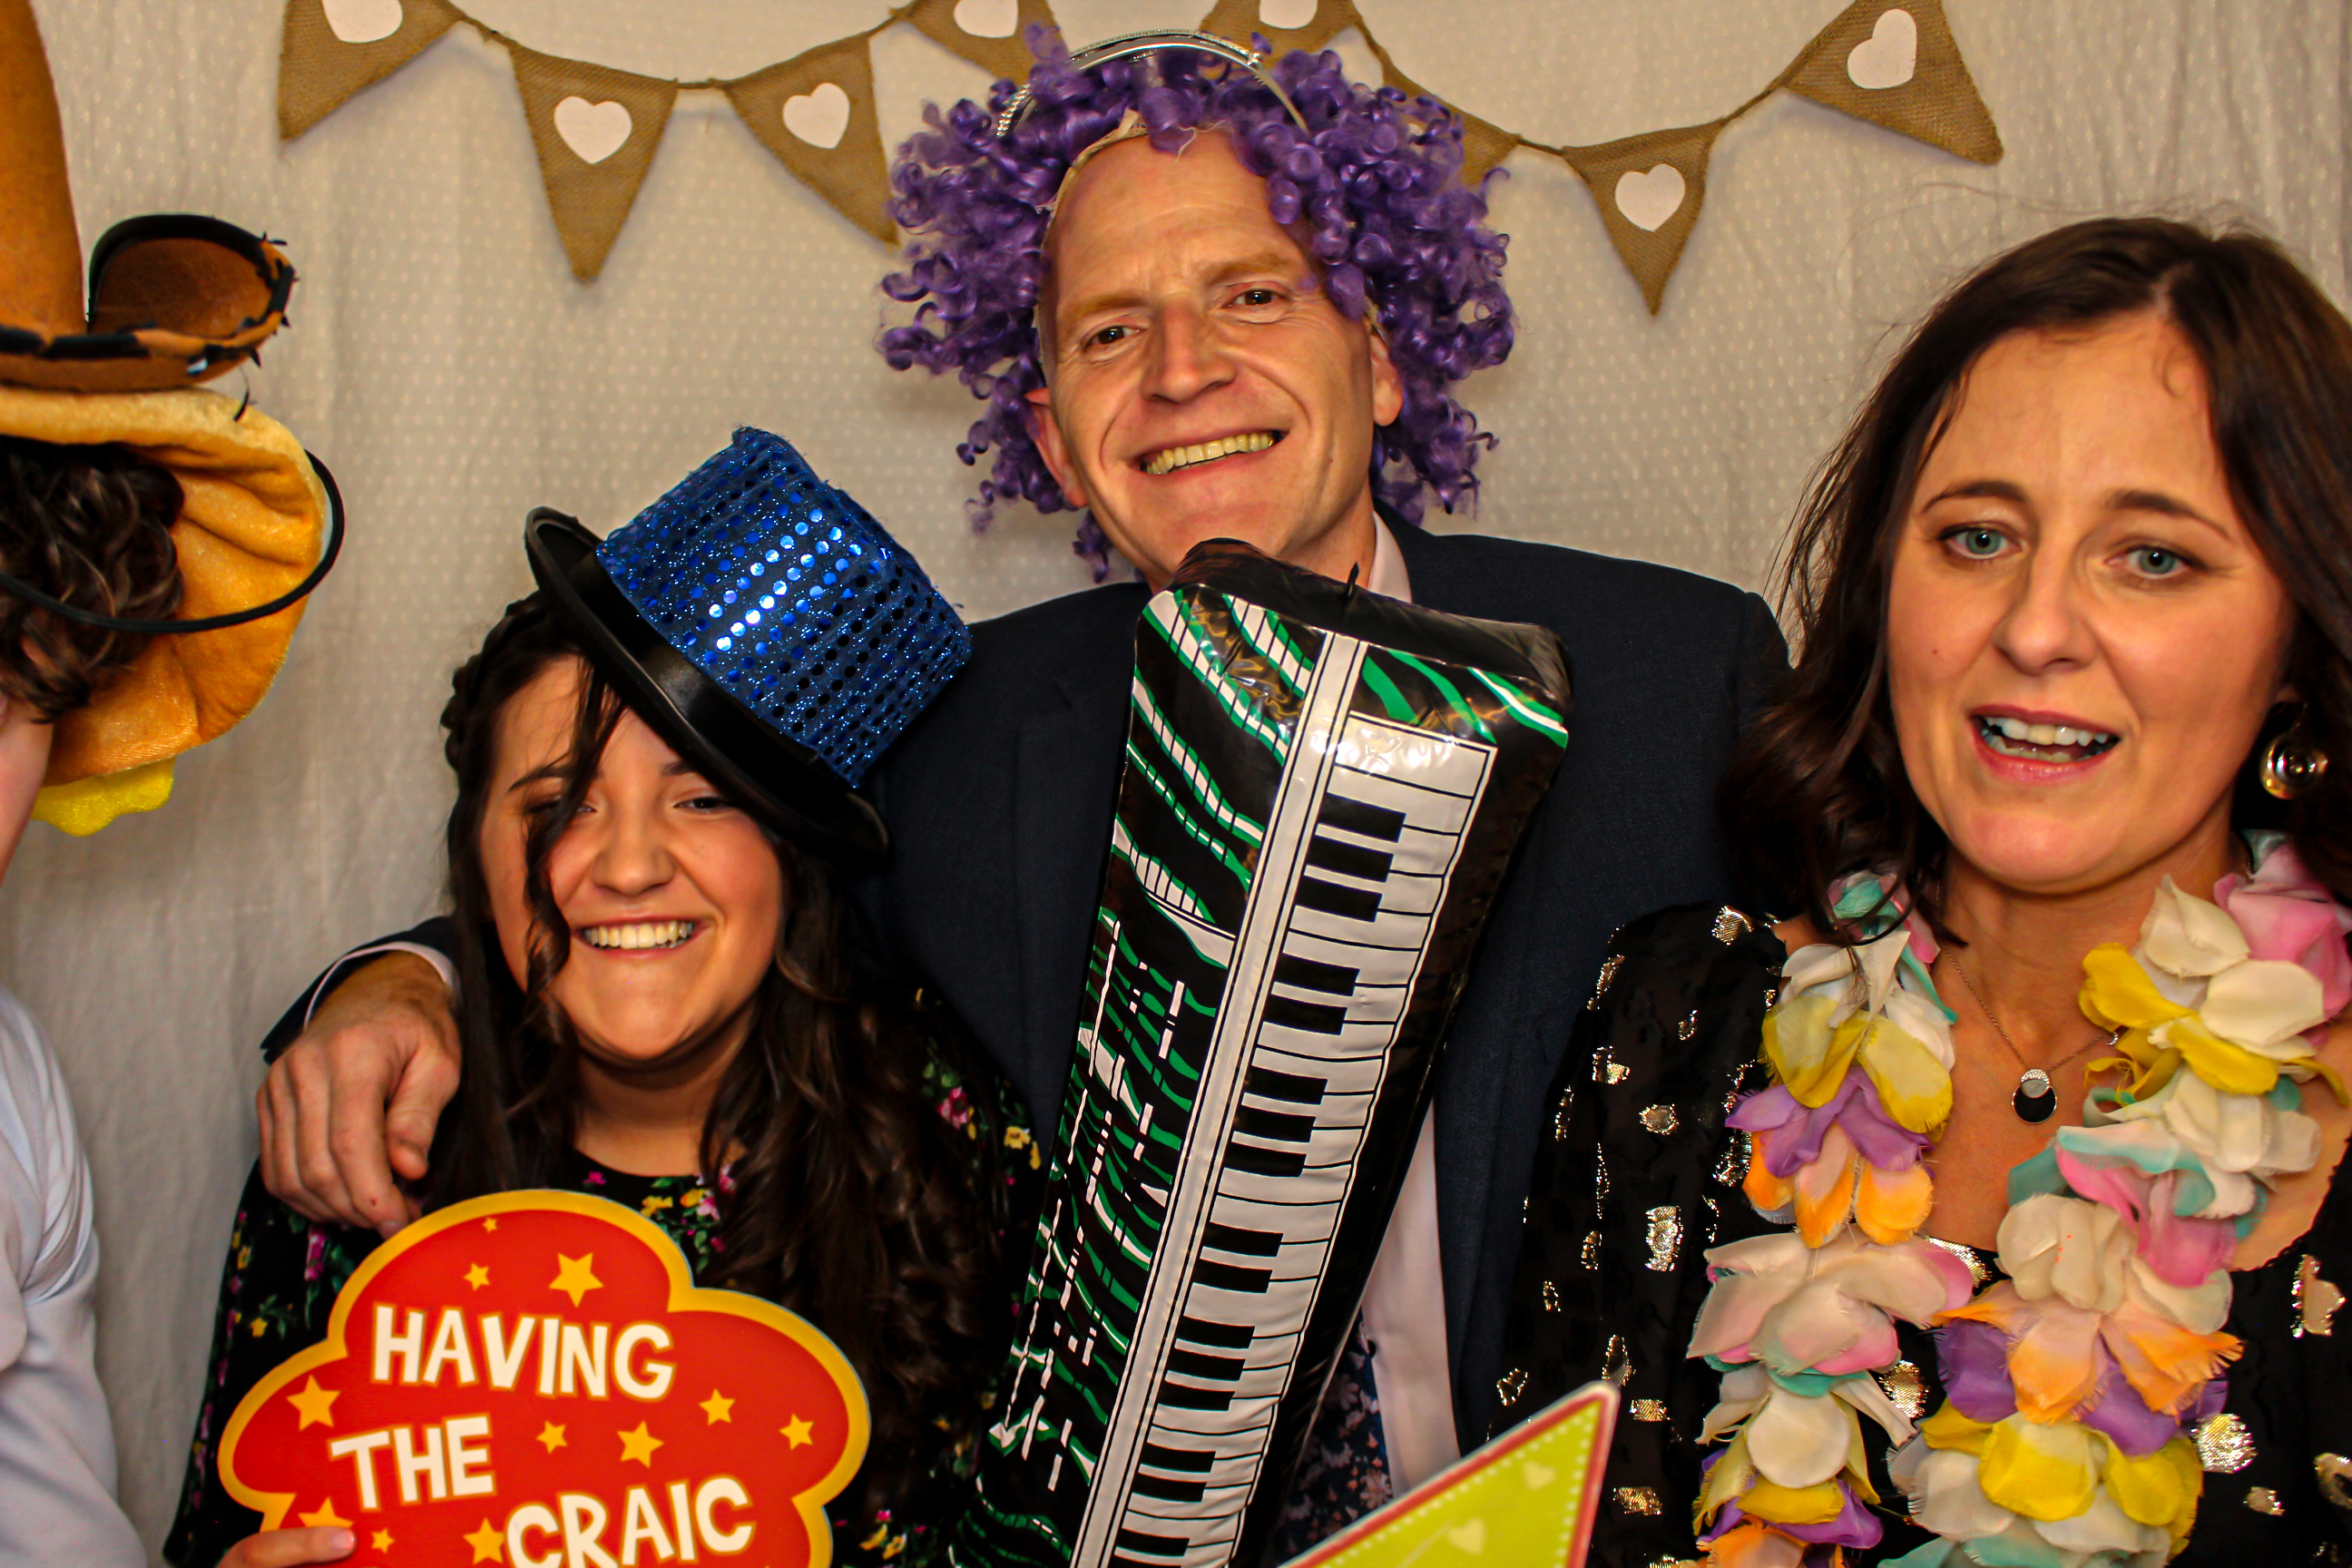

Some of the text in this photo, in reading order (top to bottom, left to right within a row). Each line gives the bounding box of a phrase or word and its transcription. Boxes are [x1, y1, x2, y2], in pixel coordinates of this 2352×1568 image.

[372, 1305, 674, 1399] HAVING
[329, 1416, 495, 1510] THE
[505, 1476, 753, 1568] CRAIC
